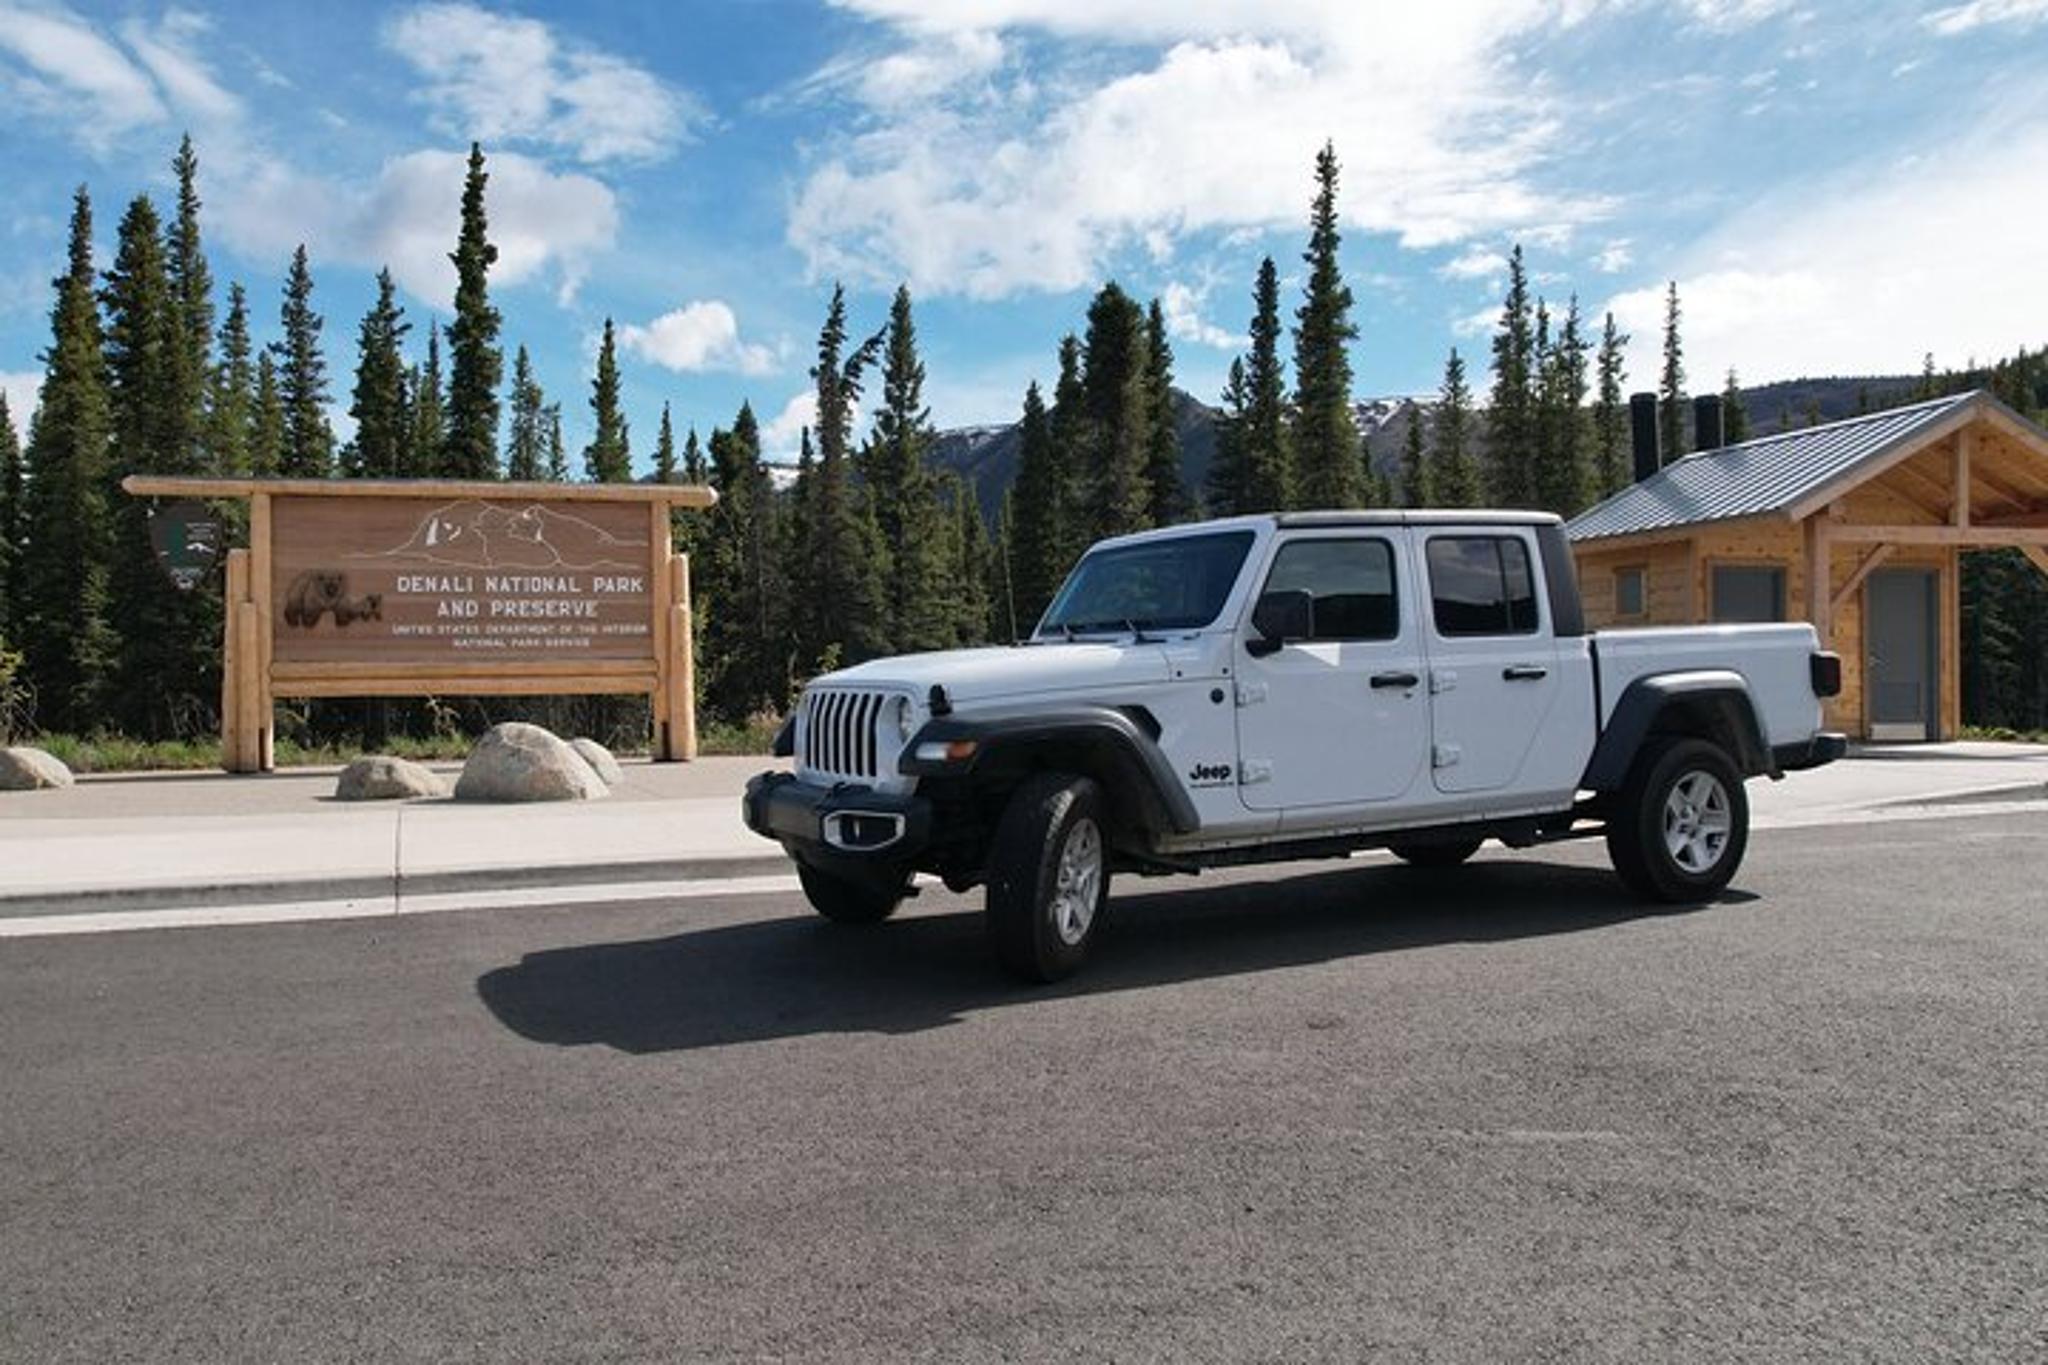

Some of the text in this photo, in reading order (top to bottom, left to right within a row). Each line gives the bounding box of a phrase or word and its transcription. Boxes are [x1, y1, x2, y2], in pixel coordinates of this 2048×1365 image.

[397, 576, 644, 593] DENALI NATIONAL PARK
[437, 600, 598, 617] AND PRESERVE
[437, 624, 479, 635] STATES
[1189, 763, 1231, 780] Jeep
